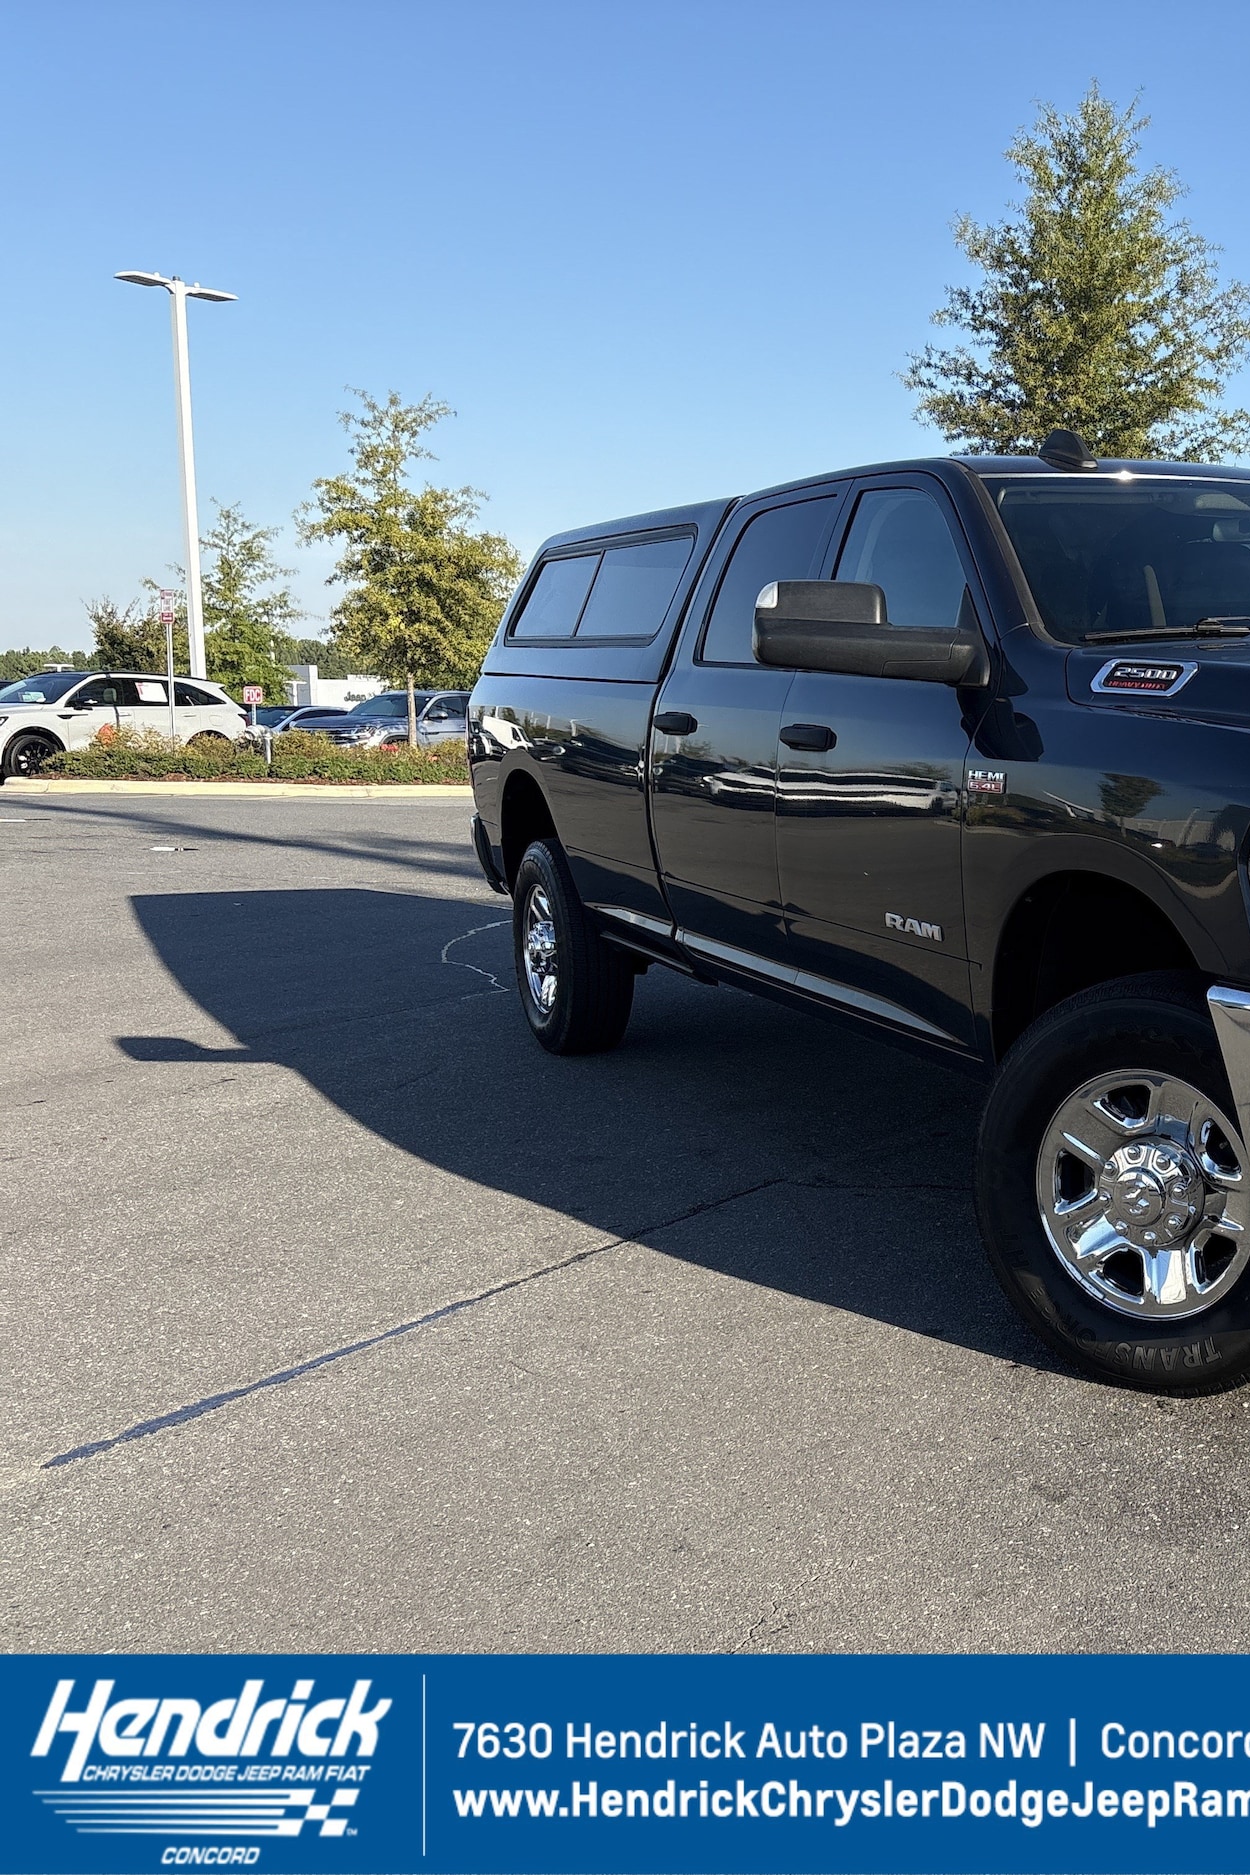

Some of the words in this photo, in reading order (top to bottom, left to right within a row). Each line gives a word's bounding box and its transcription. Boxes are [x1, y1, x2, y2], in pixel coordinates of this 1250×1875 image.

[1113, 666, 1178, 681] 2500
[244, 688, 261, 702] FDC
[968, 769, 1005, 781] HEMI
[884, 911, 943, 942] RAM
